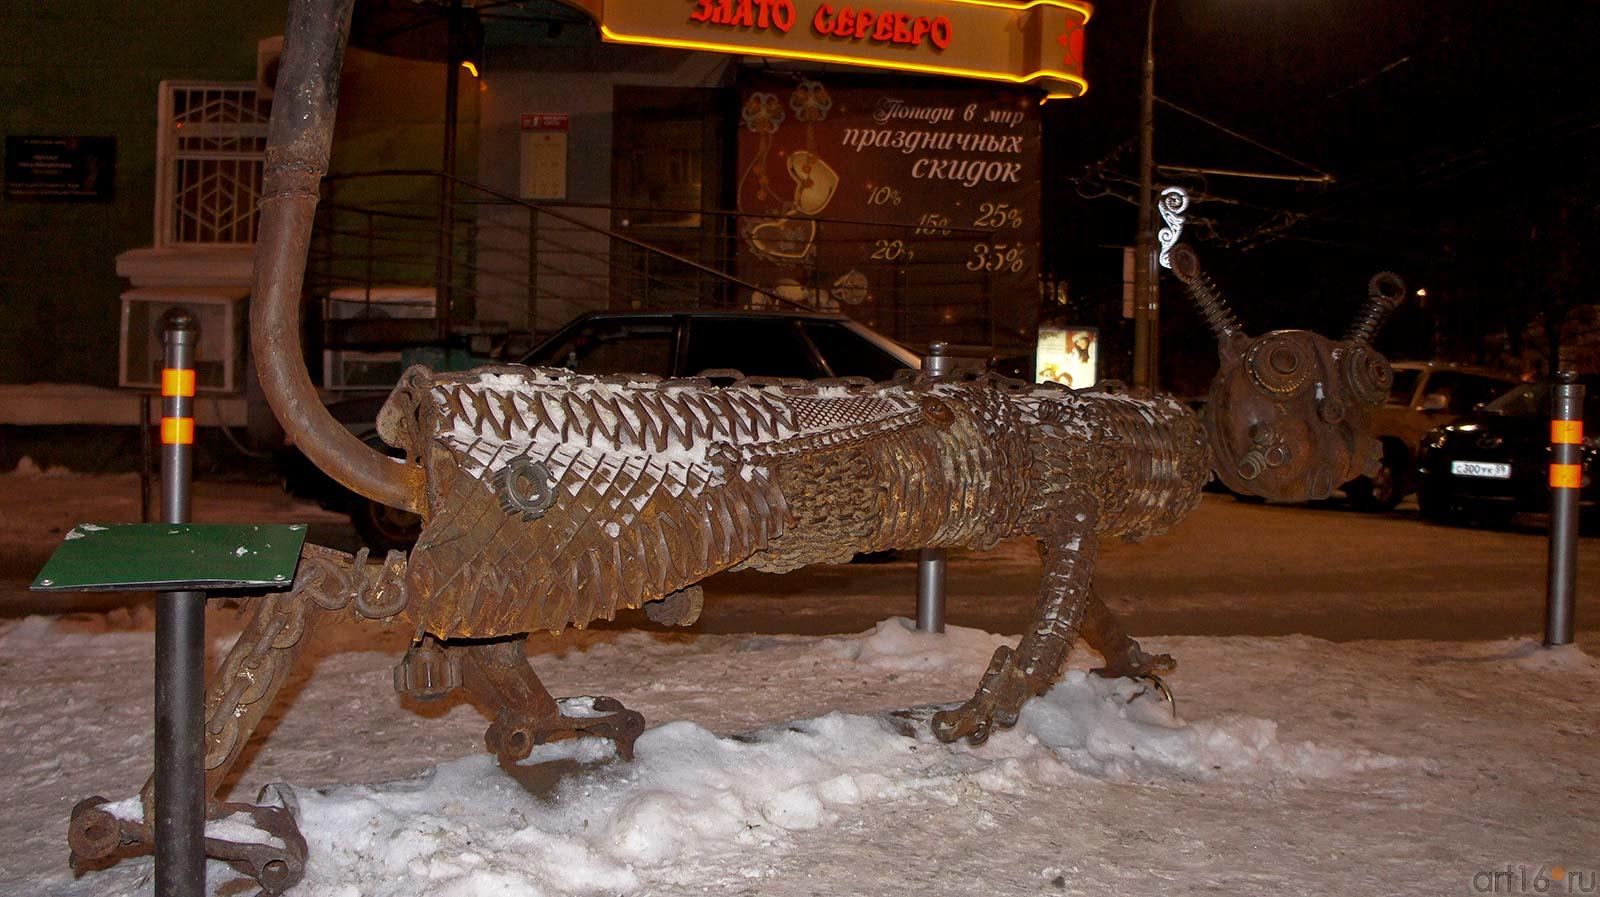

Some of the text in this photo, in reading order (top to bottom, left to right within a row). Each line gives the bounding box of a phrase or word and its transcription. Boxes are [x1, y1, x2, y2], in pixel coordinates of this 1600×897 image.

[690, 0, 953, 50] ЗЛАТО СЕРЕБРО
[873, 98, 1024, 127] Попади в мир
[842, 128, 1024, 154] праздничных
[912, 158, 1021, 187] скидок
[867, 186, 903, 207] 10%
[974, 203, 1024, 228] 25%
[967, 244, 1024, 273] 35%
